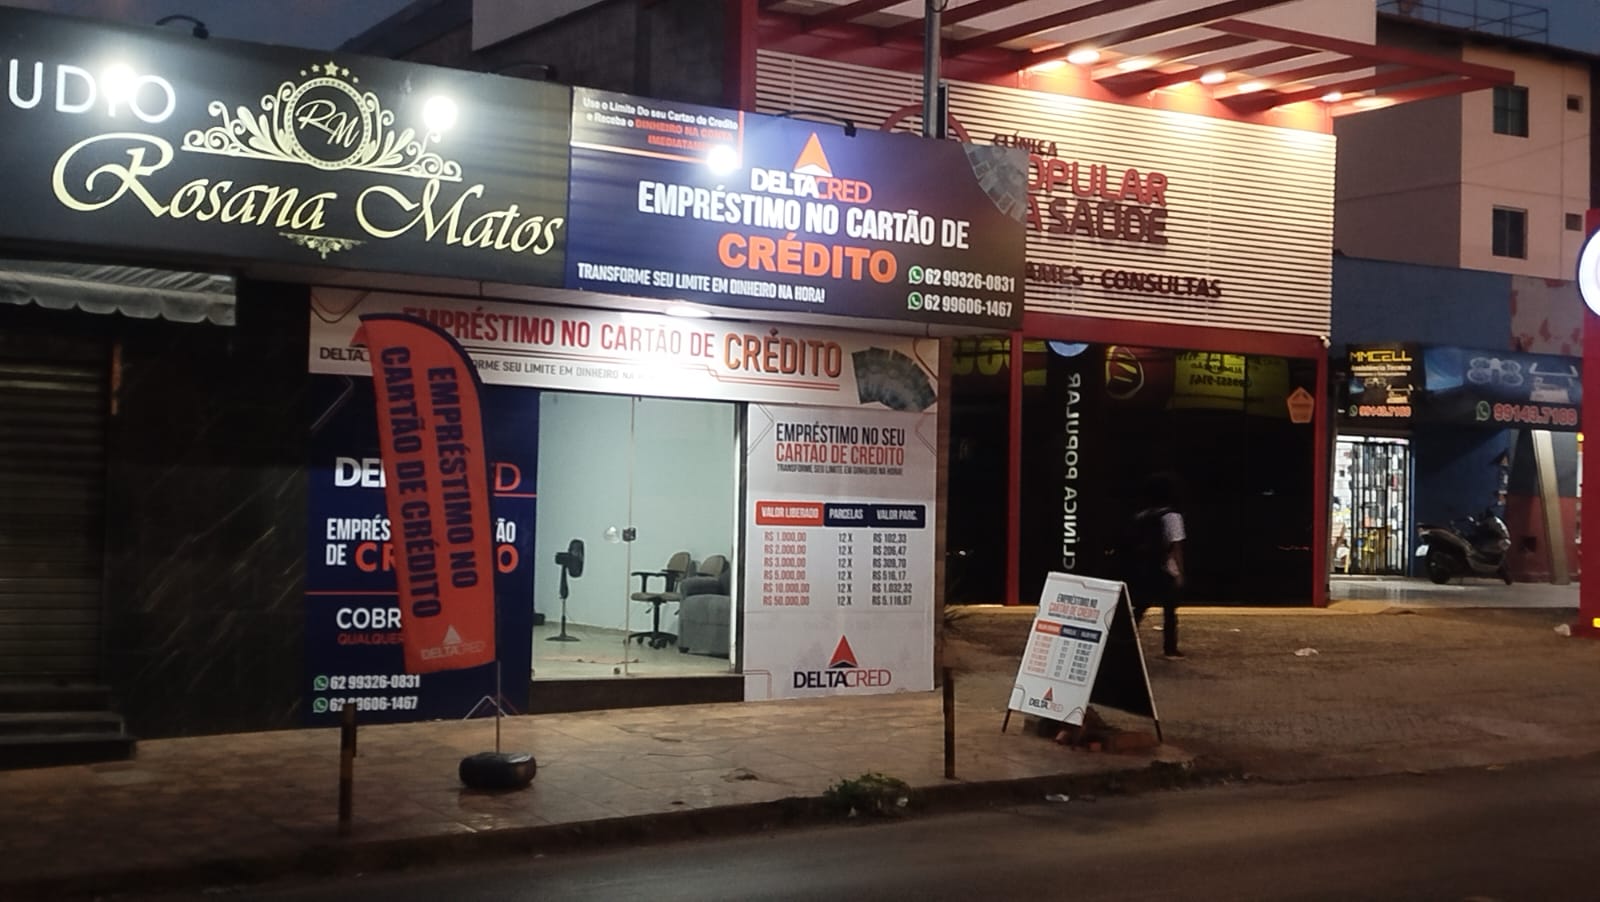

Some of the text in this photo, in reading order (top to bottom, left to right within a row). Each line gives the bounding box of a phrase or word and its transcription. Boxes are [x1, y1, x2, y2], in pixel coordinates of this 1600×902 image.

[609, 102, 636, 115] Limite
[637, 106, 649, 117] Do
[296, 99, 360, 149] RM
[594, 112, 626, 126] Receba
[635, 118, 683, 134] DINHEIRO
[684, 125, 699, 137] NA
[993, 130, 1058, 157] CLÍNICA
[751, 168, 873, 204] DELTACRED
[1027, 153, 1169, 208] OPULAR
[52, 132, 564, 255] Rosana Matos
[638, 180, 970, 249] EMPRÉSTIMO NO CARTÃO DE
[718, 232, 898, 284] CRÉDITO
[577, 262, 826, 304] TRANSFORME SEU LIMITE EM DINHEIRO NA HORA!
[925, 267, 1016, 293] 62 99326-0831
[1101, 268, 1222, 298] CONSULTAS
[924, 293, 1013, 318] 62 99606-1467
[320, 346, 369, 362] DELTA
[561, 320, 591, 348] NO
[601, 321, 682, 355] CARTÃO
[690, 331, 715, 358] DE
[723, 327, 843, 379] CRÉDITO
[503, 361, 522, 373] SEU
[524, 362, 556, 375] LIMITE
[559, 365, 573, 377] EM
[576, 366, 619, 380] DINHEIRO
[776, 421, 905, 447] EMPRÉSTIMO NO SEU
[831, 445, 847, 464] DE
[381, 346, 442, 618] CARTÃO DE CRÉDITO
[428, 367, 479, 588] EMPRÉSTIMO NO
[761, 506, 819, 519] VALOR LIBERADO
[829, 508, 863, 520] PARCELAS
[876, 509, 898, 520] VALOR
[327, 514, 391, 541] EMPRÉS
[839, 533, 847, 543] 12
[848, 533, 853, 542] X
[326, 543, 347, 566] DE
[838, 545, 847, 555] 12
[847, 546, 853, 555] X
[838, 558, 846, 568] 12
[847, 558, 852, 568] X
[838, 571, 846, 581] 12
[847, 571, 852, 580] X
[837, 583, 846, 593] 12
[846, 584, 852, 593] X
[837, 596, 846, 606] 12
[846, 596, 852, 605] X
[336, 607, 402, 629] COBR
[330, 674, 420, 690] 62 99326-0831
[794, 668, 891, 689] DELTACRED
[329, 697, 345, 712] 62
